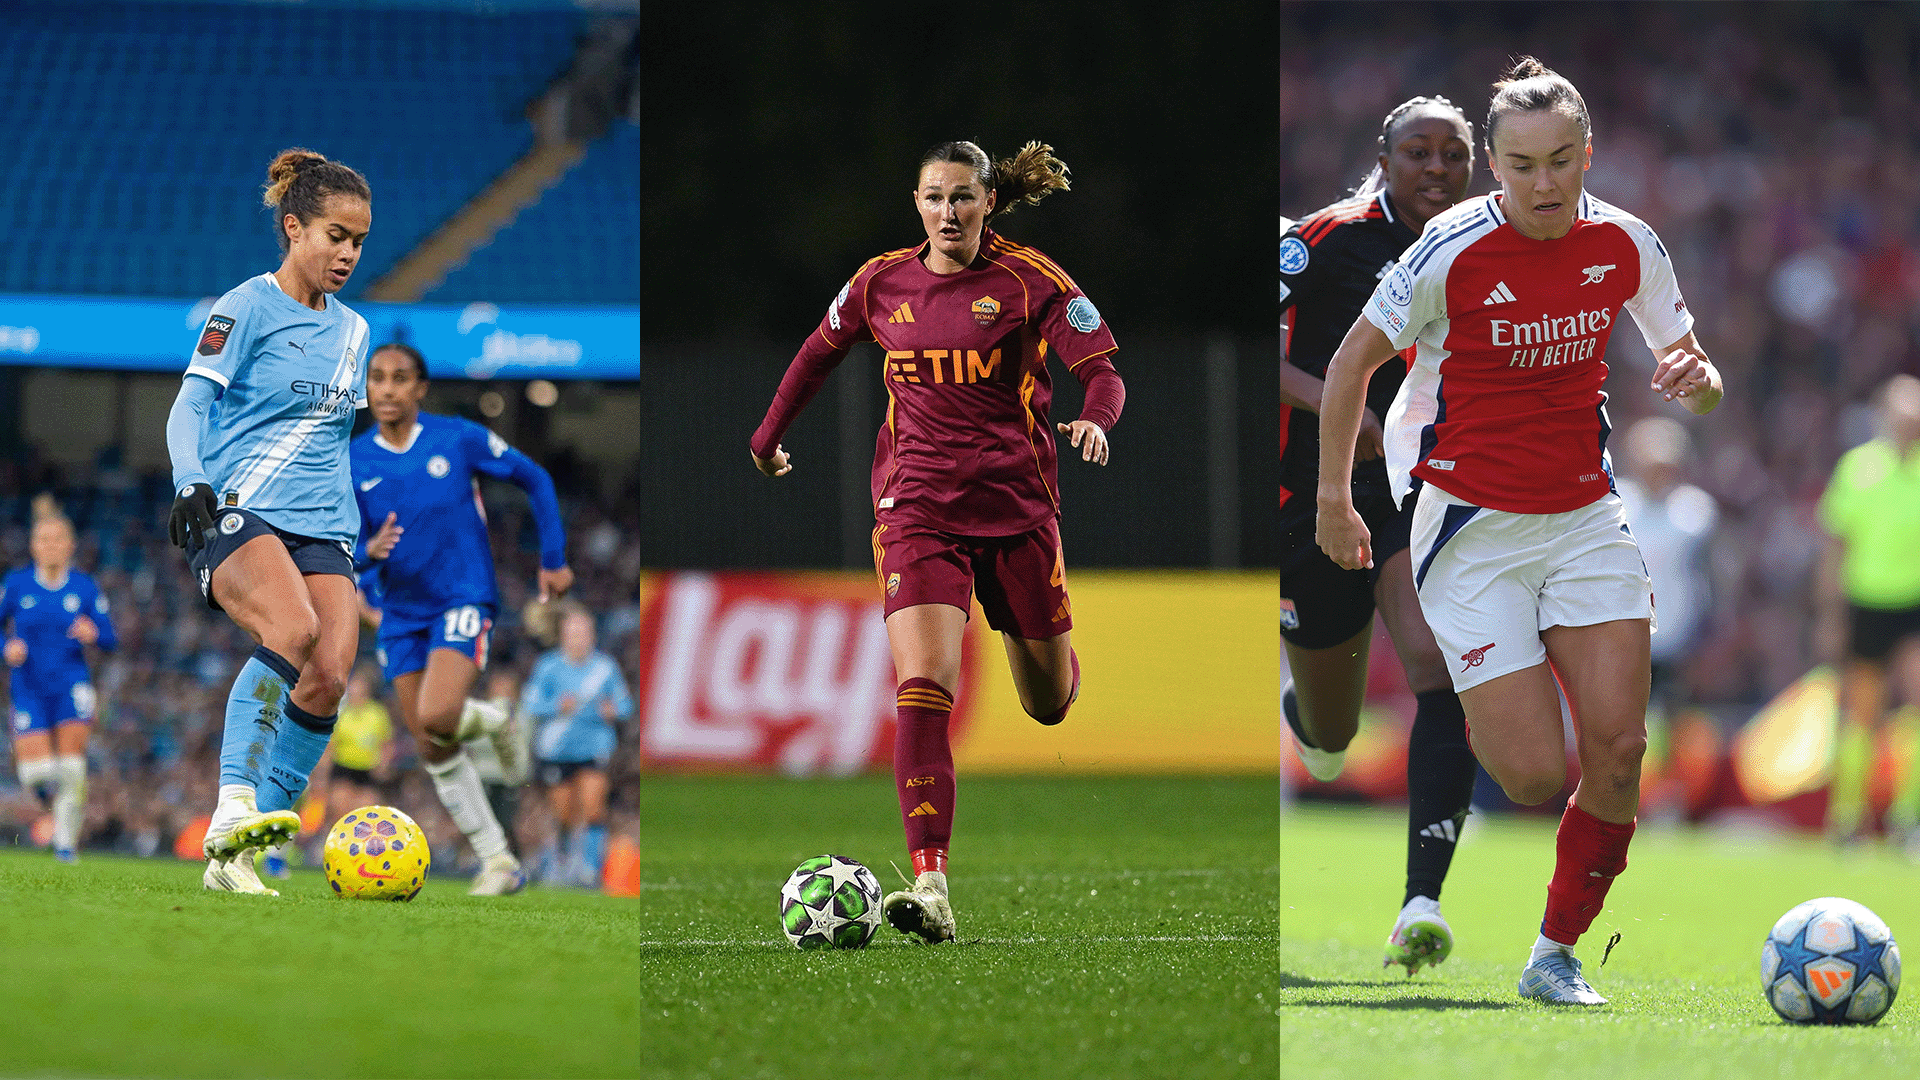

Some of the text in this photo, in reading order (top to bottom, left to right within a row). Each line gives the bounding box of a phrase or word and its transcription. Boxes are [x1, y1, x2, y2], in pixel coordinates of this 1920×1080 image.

[207, 320, 231, 333] WSL
[974, 313, 996, 321] ROMA
[1490, 307, 1611, 346] Emirates
[1509, 337, 1597, 368] FLY BETTER
[922, 348, 1002, 384] TIM
[306, 401, 349, 417] AIRWAYS
[444, 604, 481, 642] 10
[905, 776, 936, 788] ASR
